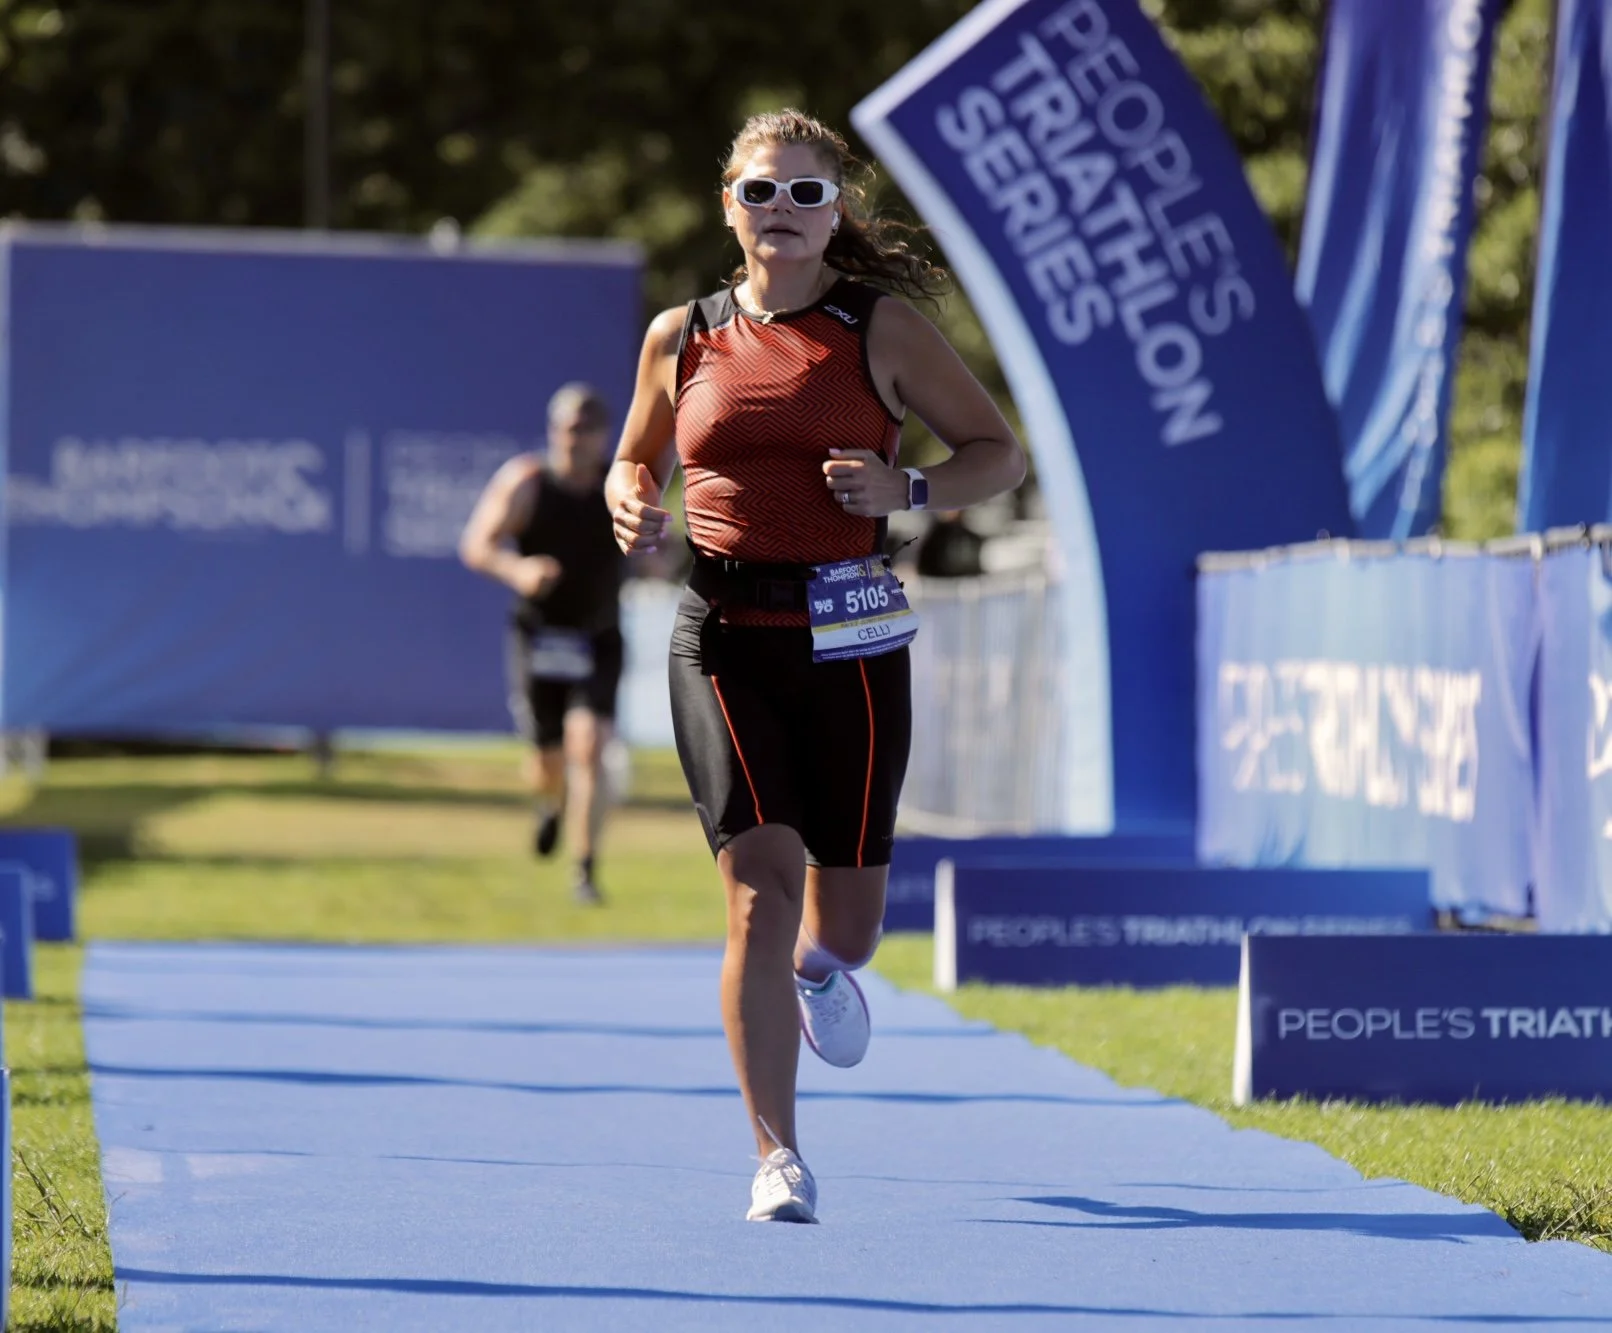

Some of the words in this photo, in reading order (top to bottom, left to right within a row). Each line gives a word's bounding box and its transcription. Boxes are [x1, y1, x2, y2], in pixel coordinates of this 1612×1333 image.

[934, 85, 1115, 347] SERIES
[989, 30, 1224, 447] TRIATHLON
[1038, 0, 1256, 336] PEOPLE'S
[823, 303, 859, 324] 2XU
[845, 584, 889, 613] 5105
[1278, 1006, 1476, 1040] PEOPLE'S
